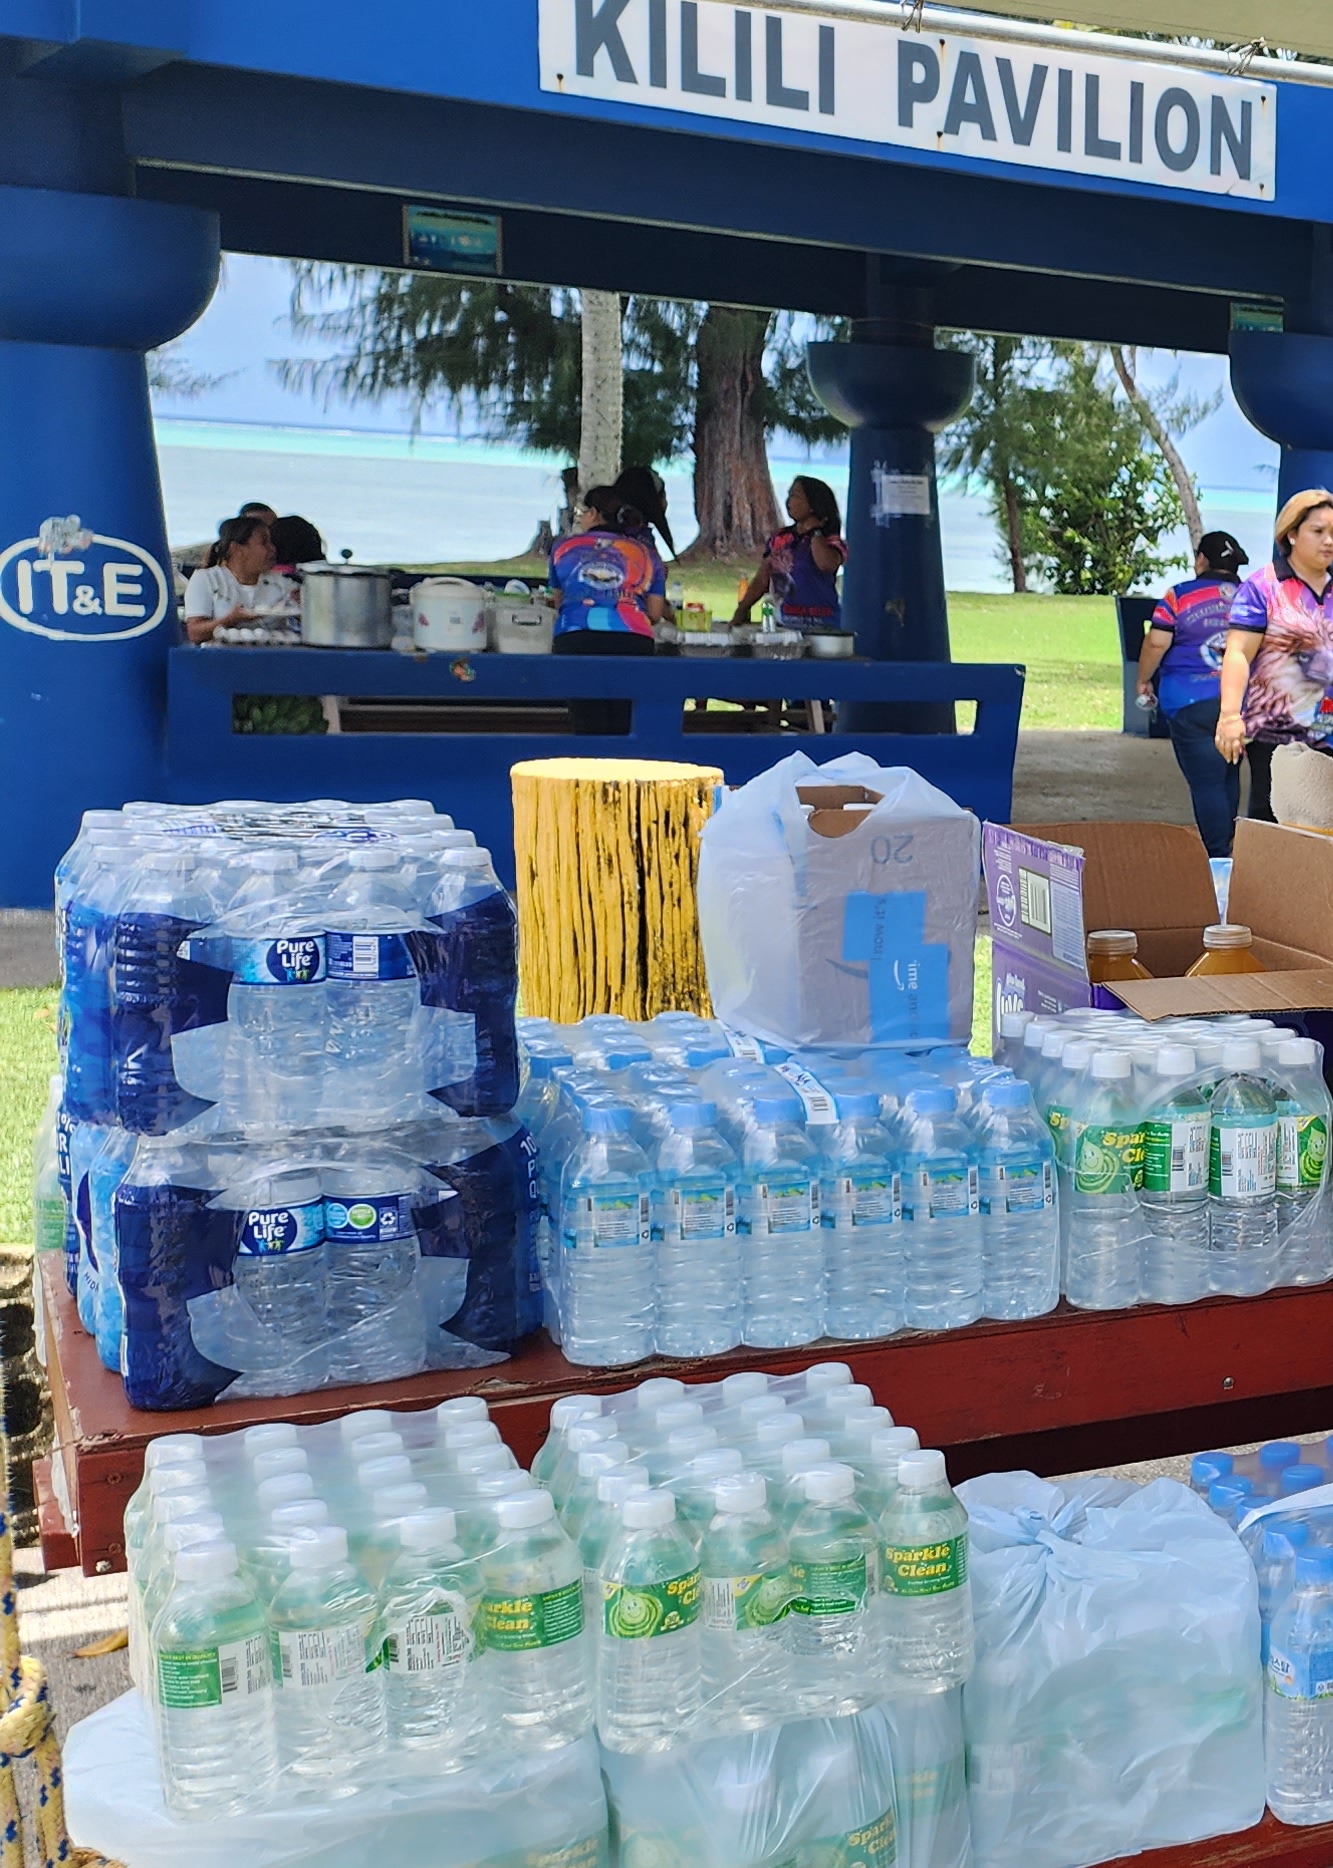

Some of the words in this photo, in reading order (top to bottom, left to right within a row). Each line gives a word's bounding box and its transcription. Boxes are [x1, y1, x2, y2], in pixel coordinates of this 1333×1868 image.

[575, 0, 836, 115] KILILI
[897, 39, 1252, 181] PAVILION
[17, 559, 146, 618] IT&E
[276, 939, 315, 956] Pure
[281, 952, 312, 968] Life
[247, 1210, 289, 1228] Pure
[253, 1223, 288, 1240] Life
[886, 1544, 950, 1564] Sparkle
[898, 1561, 947, 1577] Clean
[482, 1599, 533, 1615] arkle
